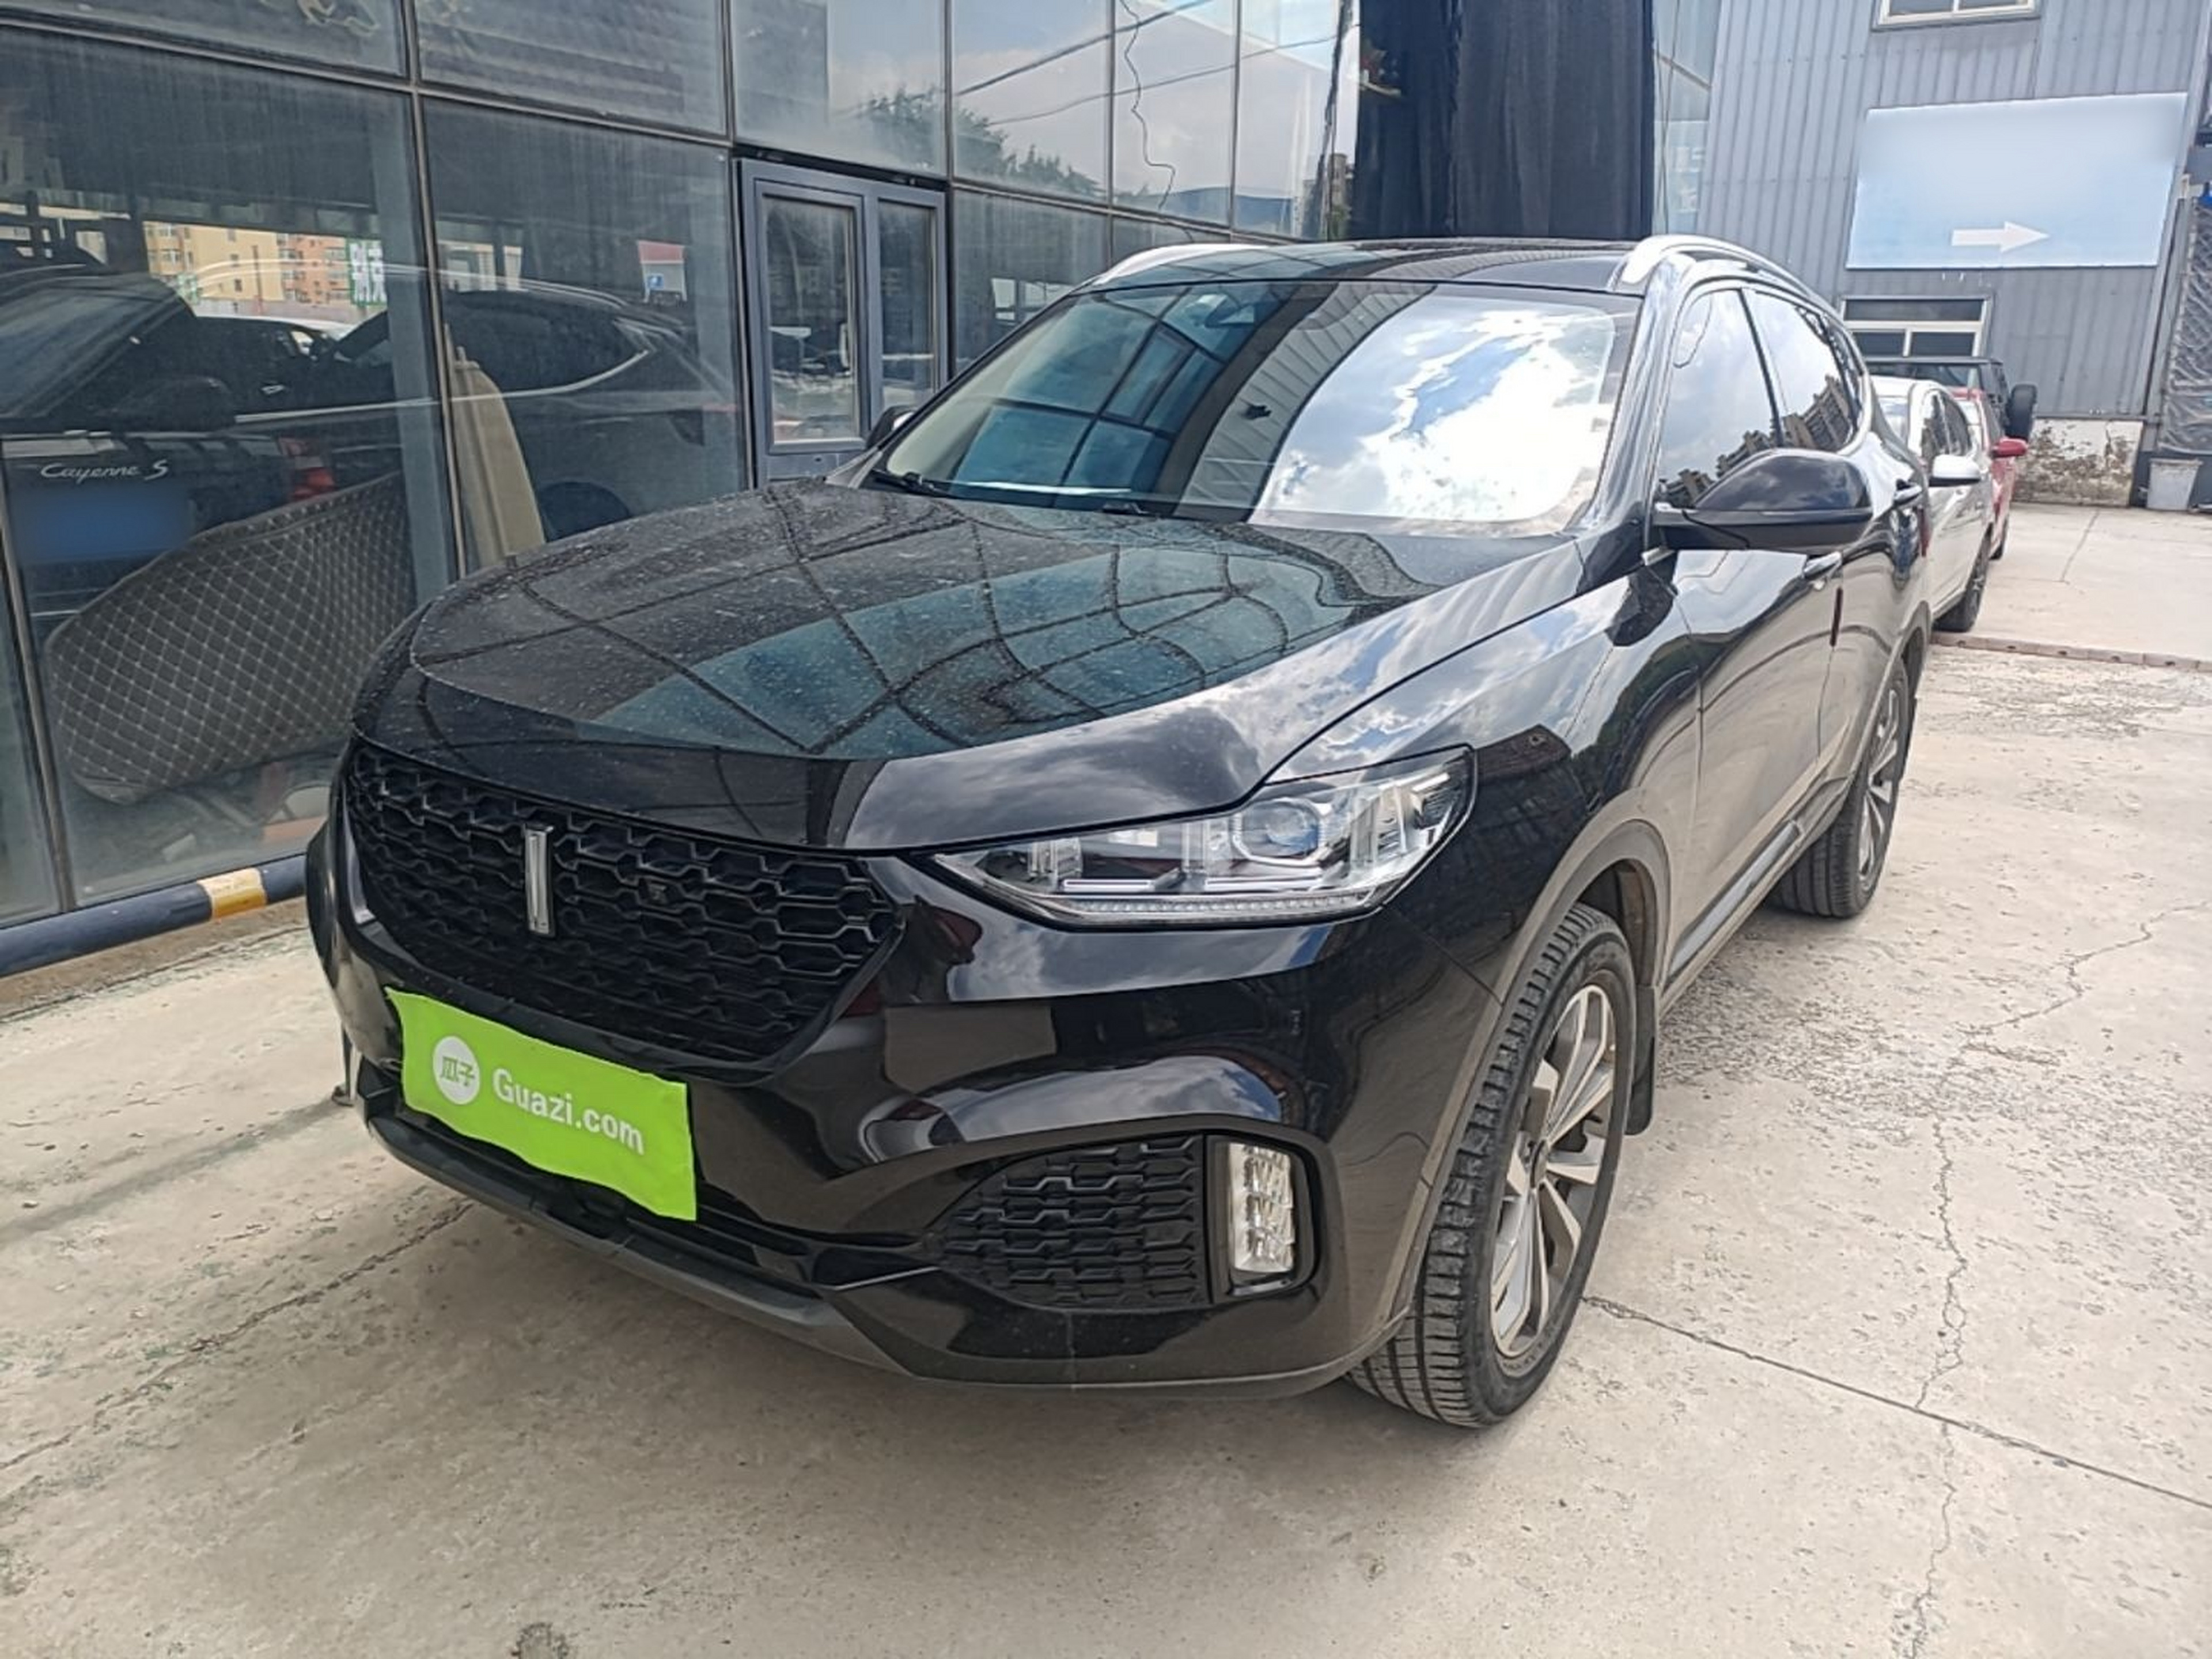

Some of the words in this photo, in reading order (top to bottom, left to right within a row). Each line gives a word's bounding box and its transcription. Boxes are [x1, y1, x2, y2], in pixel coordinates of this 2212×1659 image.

[41, 462, 141, 485] Cayenne
[145, 459, 169, 481] S
[440, 1055, 475, 1088] 瓜子
[493, 1067, 645, 1156] Guazi.com
